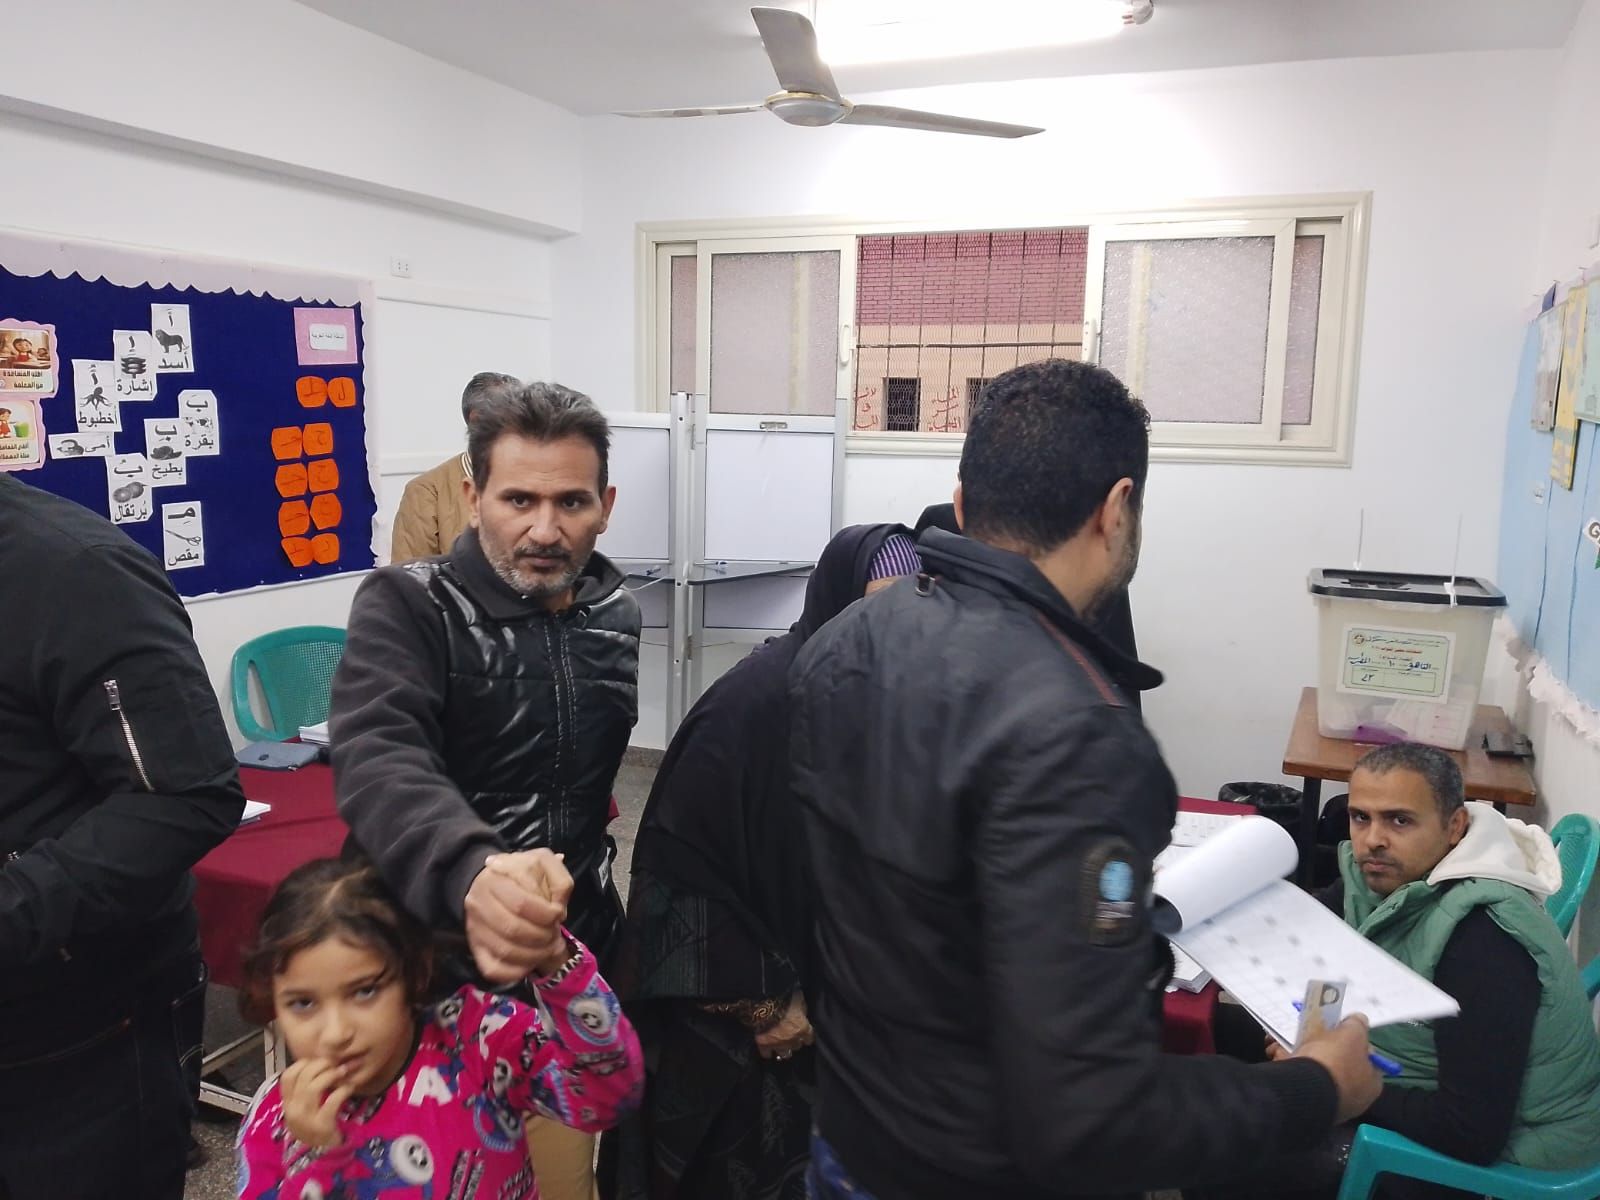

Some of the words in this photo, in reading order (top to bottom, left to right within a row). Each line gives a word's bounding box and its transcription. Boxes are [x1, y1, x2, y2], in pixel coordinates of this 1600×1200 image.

[158, 351, 189, 369] أسد
[78, 405, 118, 428] أخطبوط
[184, 433, 214, 451] بقرة
[152, 462, 183, 480] بطيخ
[168, 548, 200, 567] مقص
